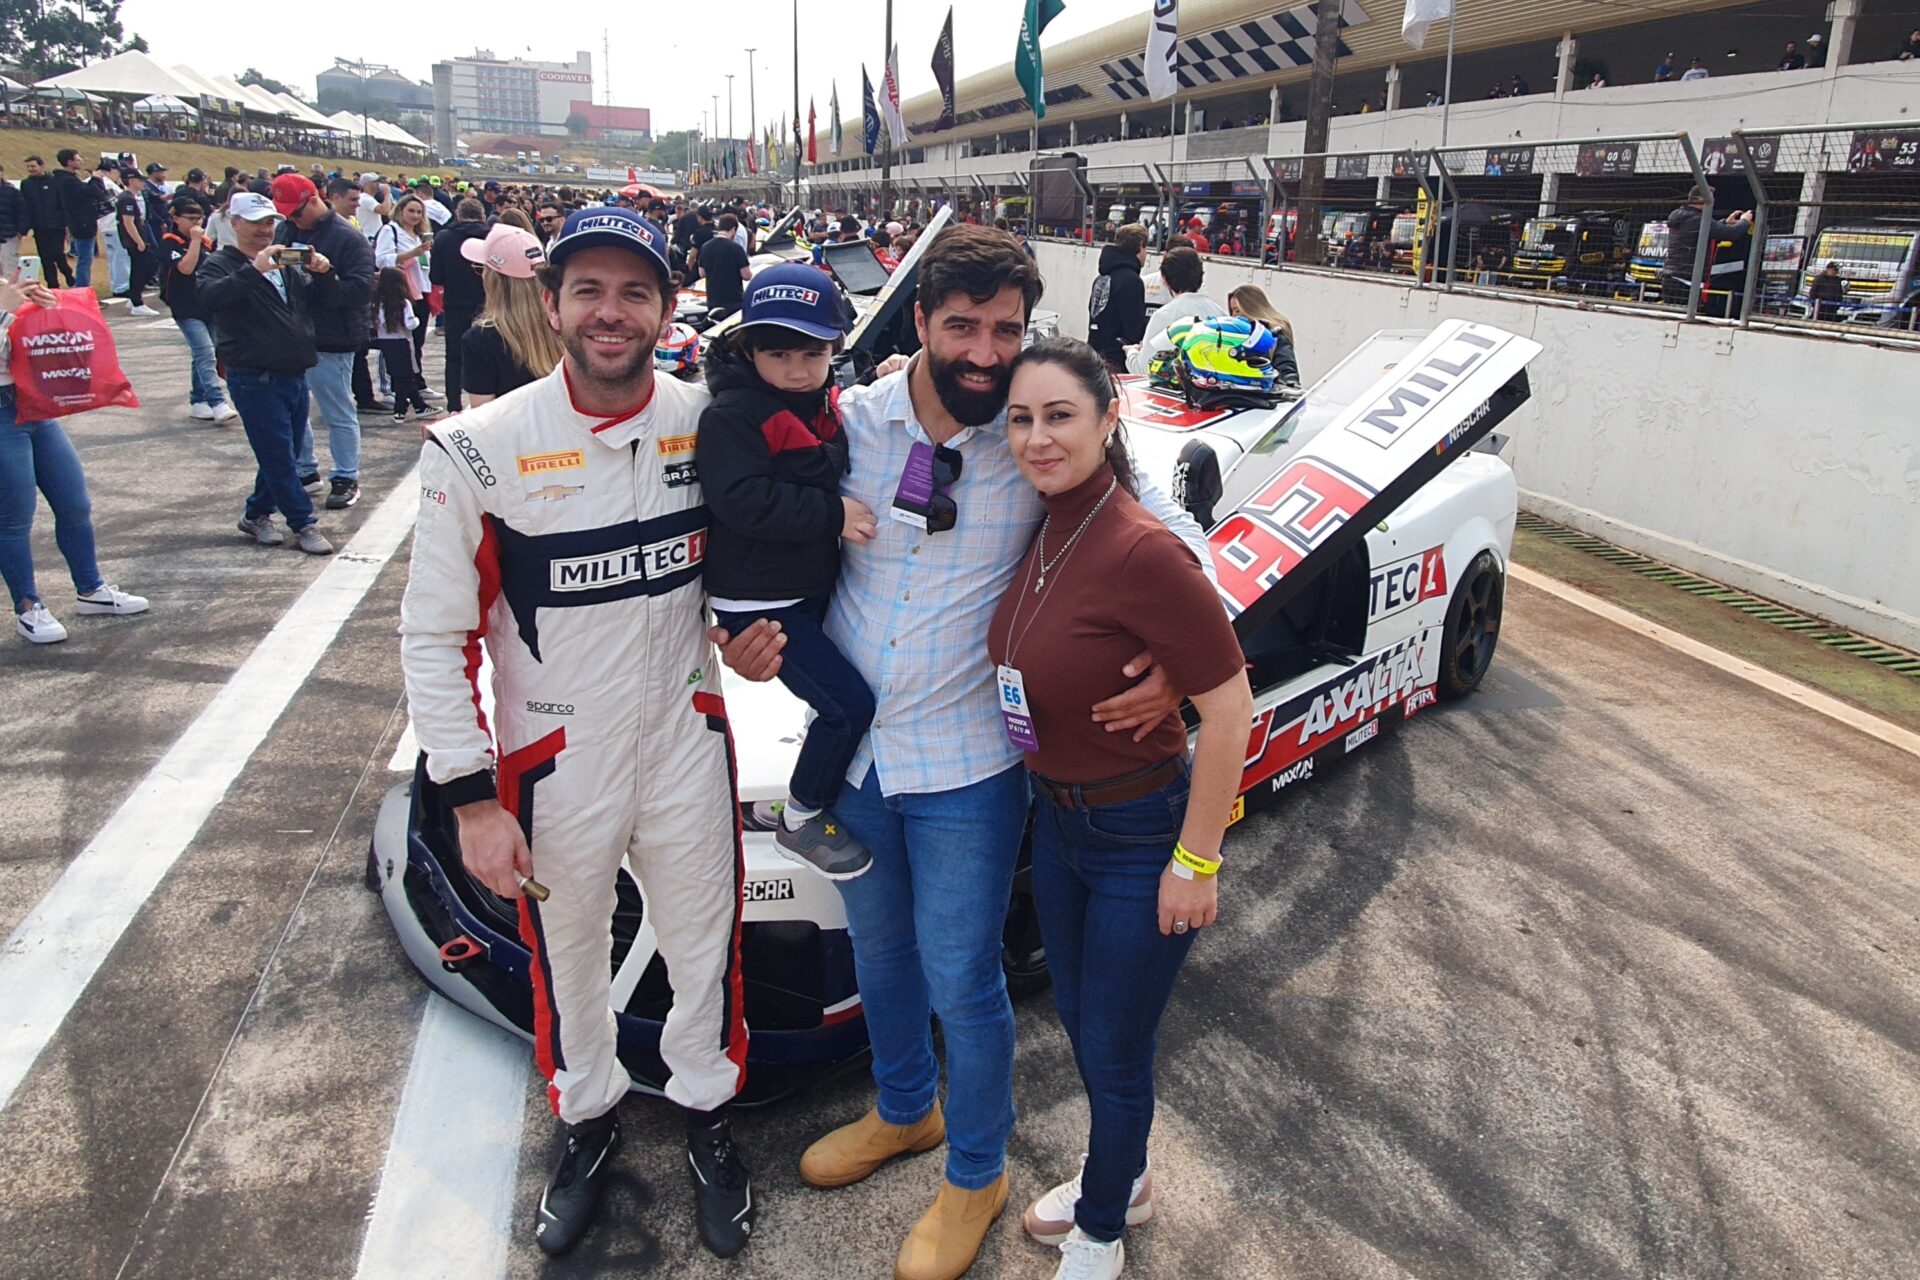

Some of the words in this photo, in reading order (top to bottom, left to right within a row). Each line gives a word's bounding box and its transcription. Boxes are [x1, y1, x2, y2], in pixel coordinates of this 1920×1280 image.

[541, 71, 591, 82] COOPAVEL
[1899, 142, 1919, 155] 55
[579, 216, 653, 243] MILITEC1
[754, 287, 818, 304] MILITEC1
[45, 343, 95, 356] RACING
[1449, 399, 1492, 445] NASCAR
[450, 428, 497, 488] sparco
[520, 450, 582, 473] PIRELLI
[559, 534, 705, 586] MILITEC1
[1003, 684, 1022, 705] E6
[1298, 640, 1422, 746] AXALTA
[526, 699, 575, 715] sparco
[1347, 720, 1377, 748] MILITEC1
